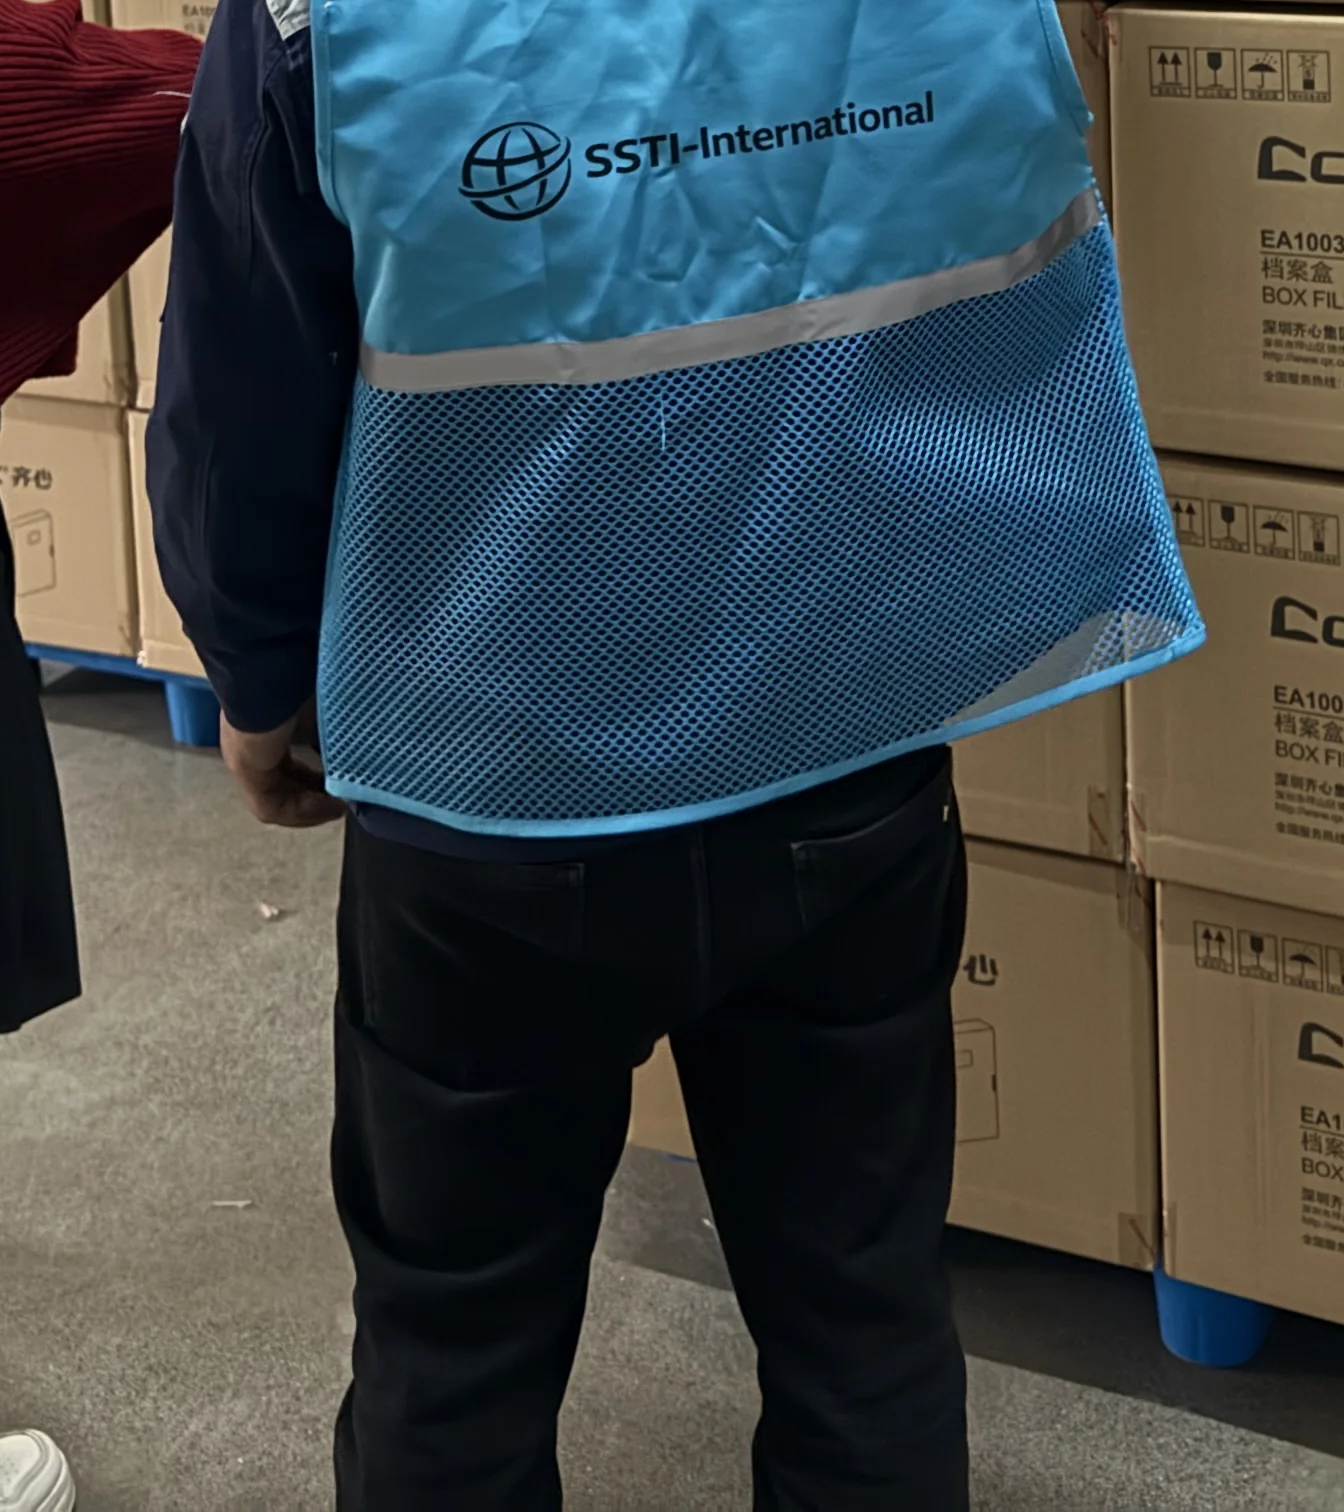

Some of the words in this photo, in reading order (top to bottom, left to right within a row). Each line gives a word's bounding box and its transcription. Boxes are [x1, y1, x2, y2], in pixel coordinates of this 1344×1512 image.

[585, 91, 935, 179] SSTI-International
[1261, 256, 1334, 284] 档案盒
[1262, 285, 1308, 307] BOX
[1274, 712, 1344, 745] 档案盒
[1275, 739, 1320, 764] BOX
[1301, 1156, 1344, 1183] BOX
